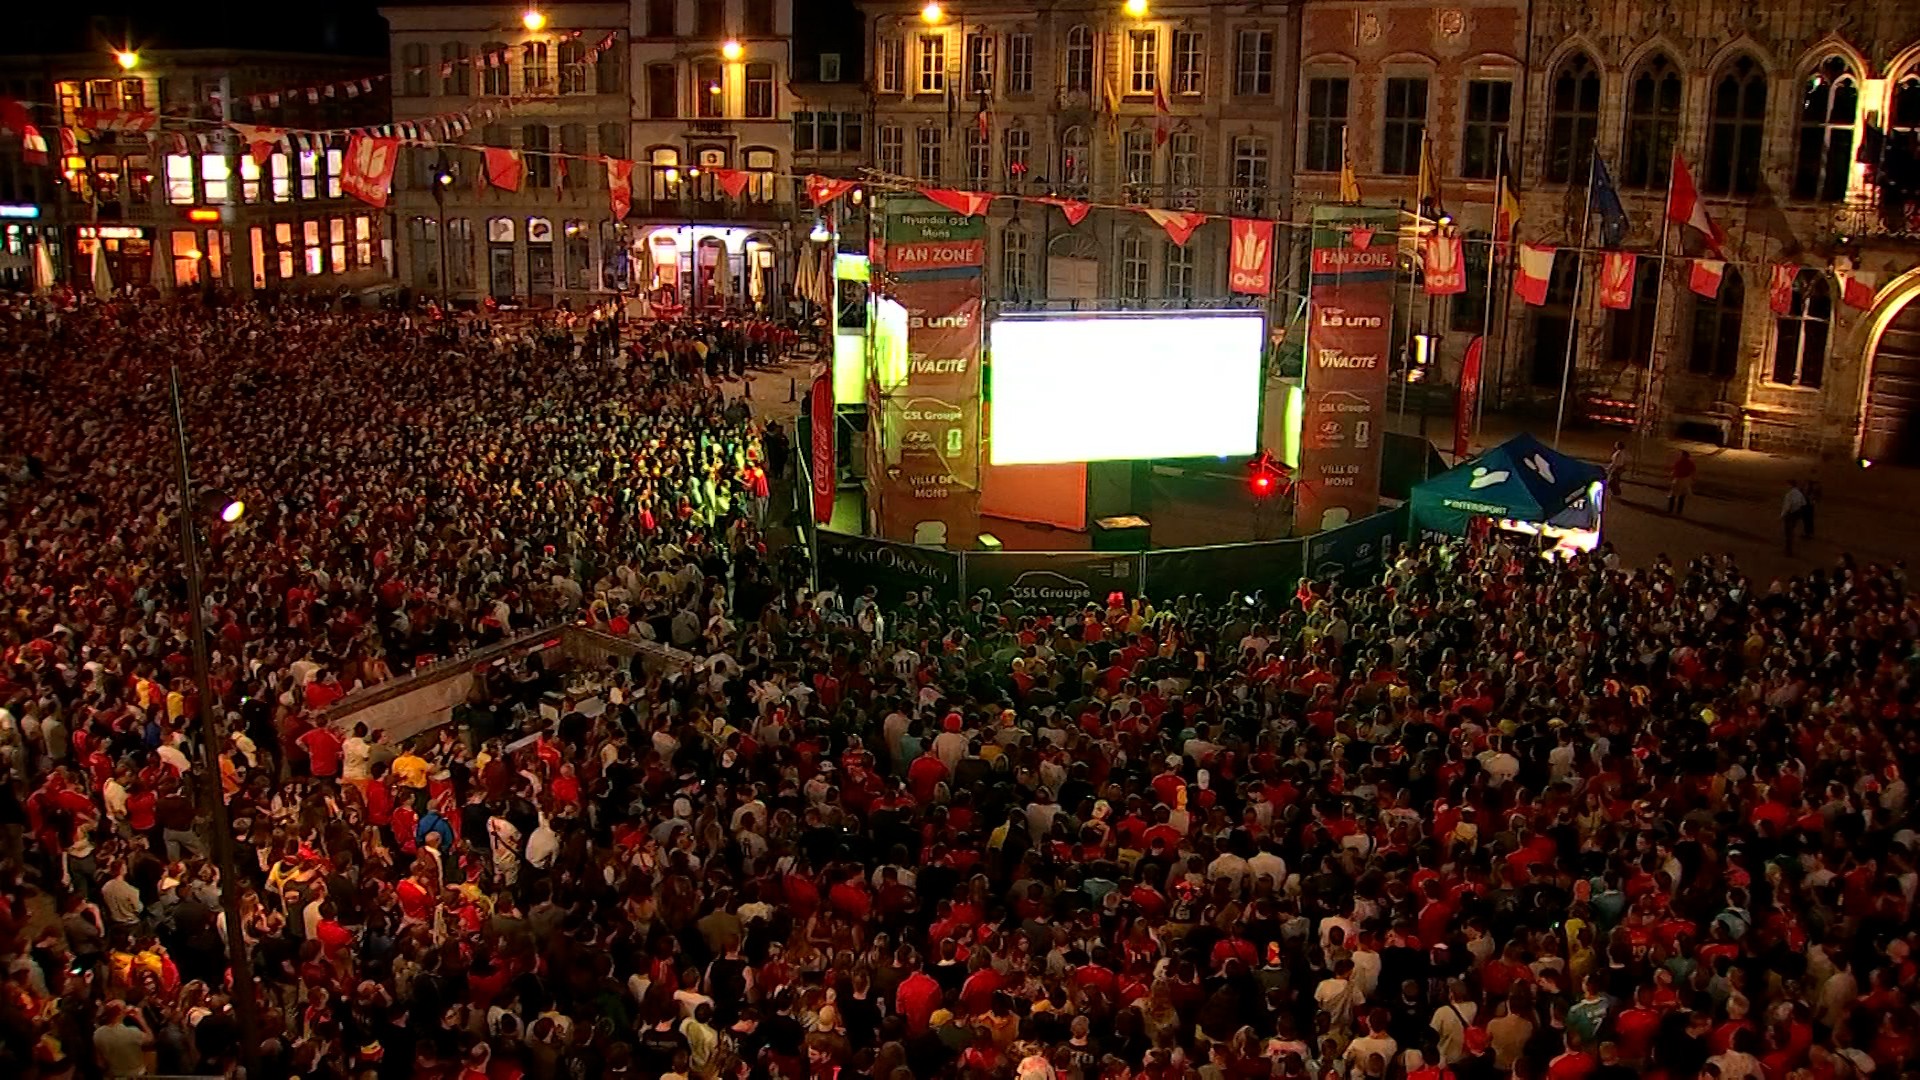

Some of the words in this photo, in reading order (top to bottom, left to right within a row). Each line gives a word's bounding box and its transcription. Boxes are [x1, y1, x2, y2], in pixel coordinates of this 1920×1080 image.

[902, 215, 947, 226] Hyundai
[897, 248, 928, 260] FAN
[933, 248, 973, 261] ZONE
[1322, 251, 1349, 264] FAN
[1353, 253, 1388, 265] ZONE
[928, 316, 968, 328] une
[1321, 312, 1343, 327] La
[1345, 316, 1381, 328] une
[909, 357, 968, 373] IVACITÉ
[1320, 354, 1378, 368] VIVACITÉ
[924, 410, 962, 421] Groupe
[1321, 465, 1344, 474] VILLE
[909, 475, 936, 485] VILLE
[939, 475, 953, 485] DE
[1325, 477, 1354, 486] MONS
[914, 489, 948, 498] MONS
[1013, 587, 1036, 598] GSL
[1040, 587, 1091, 599] Groupe
